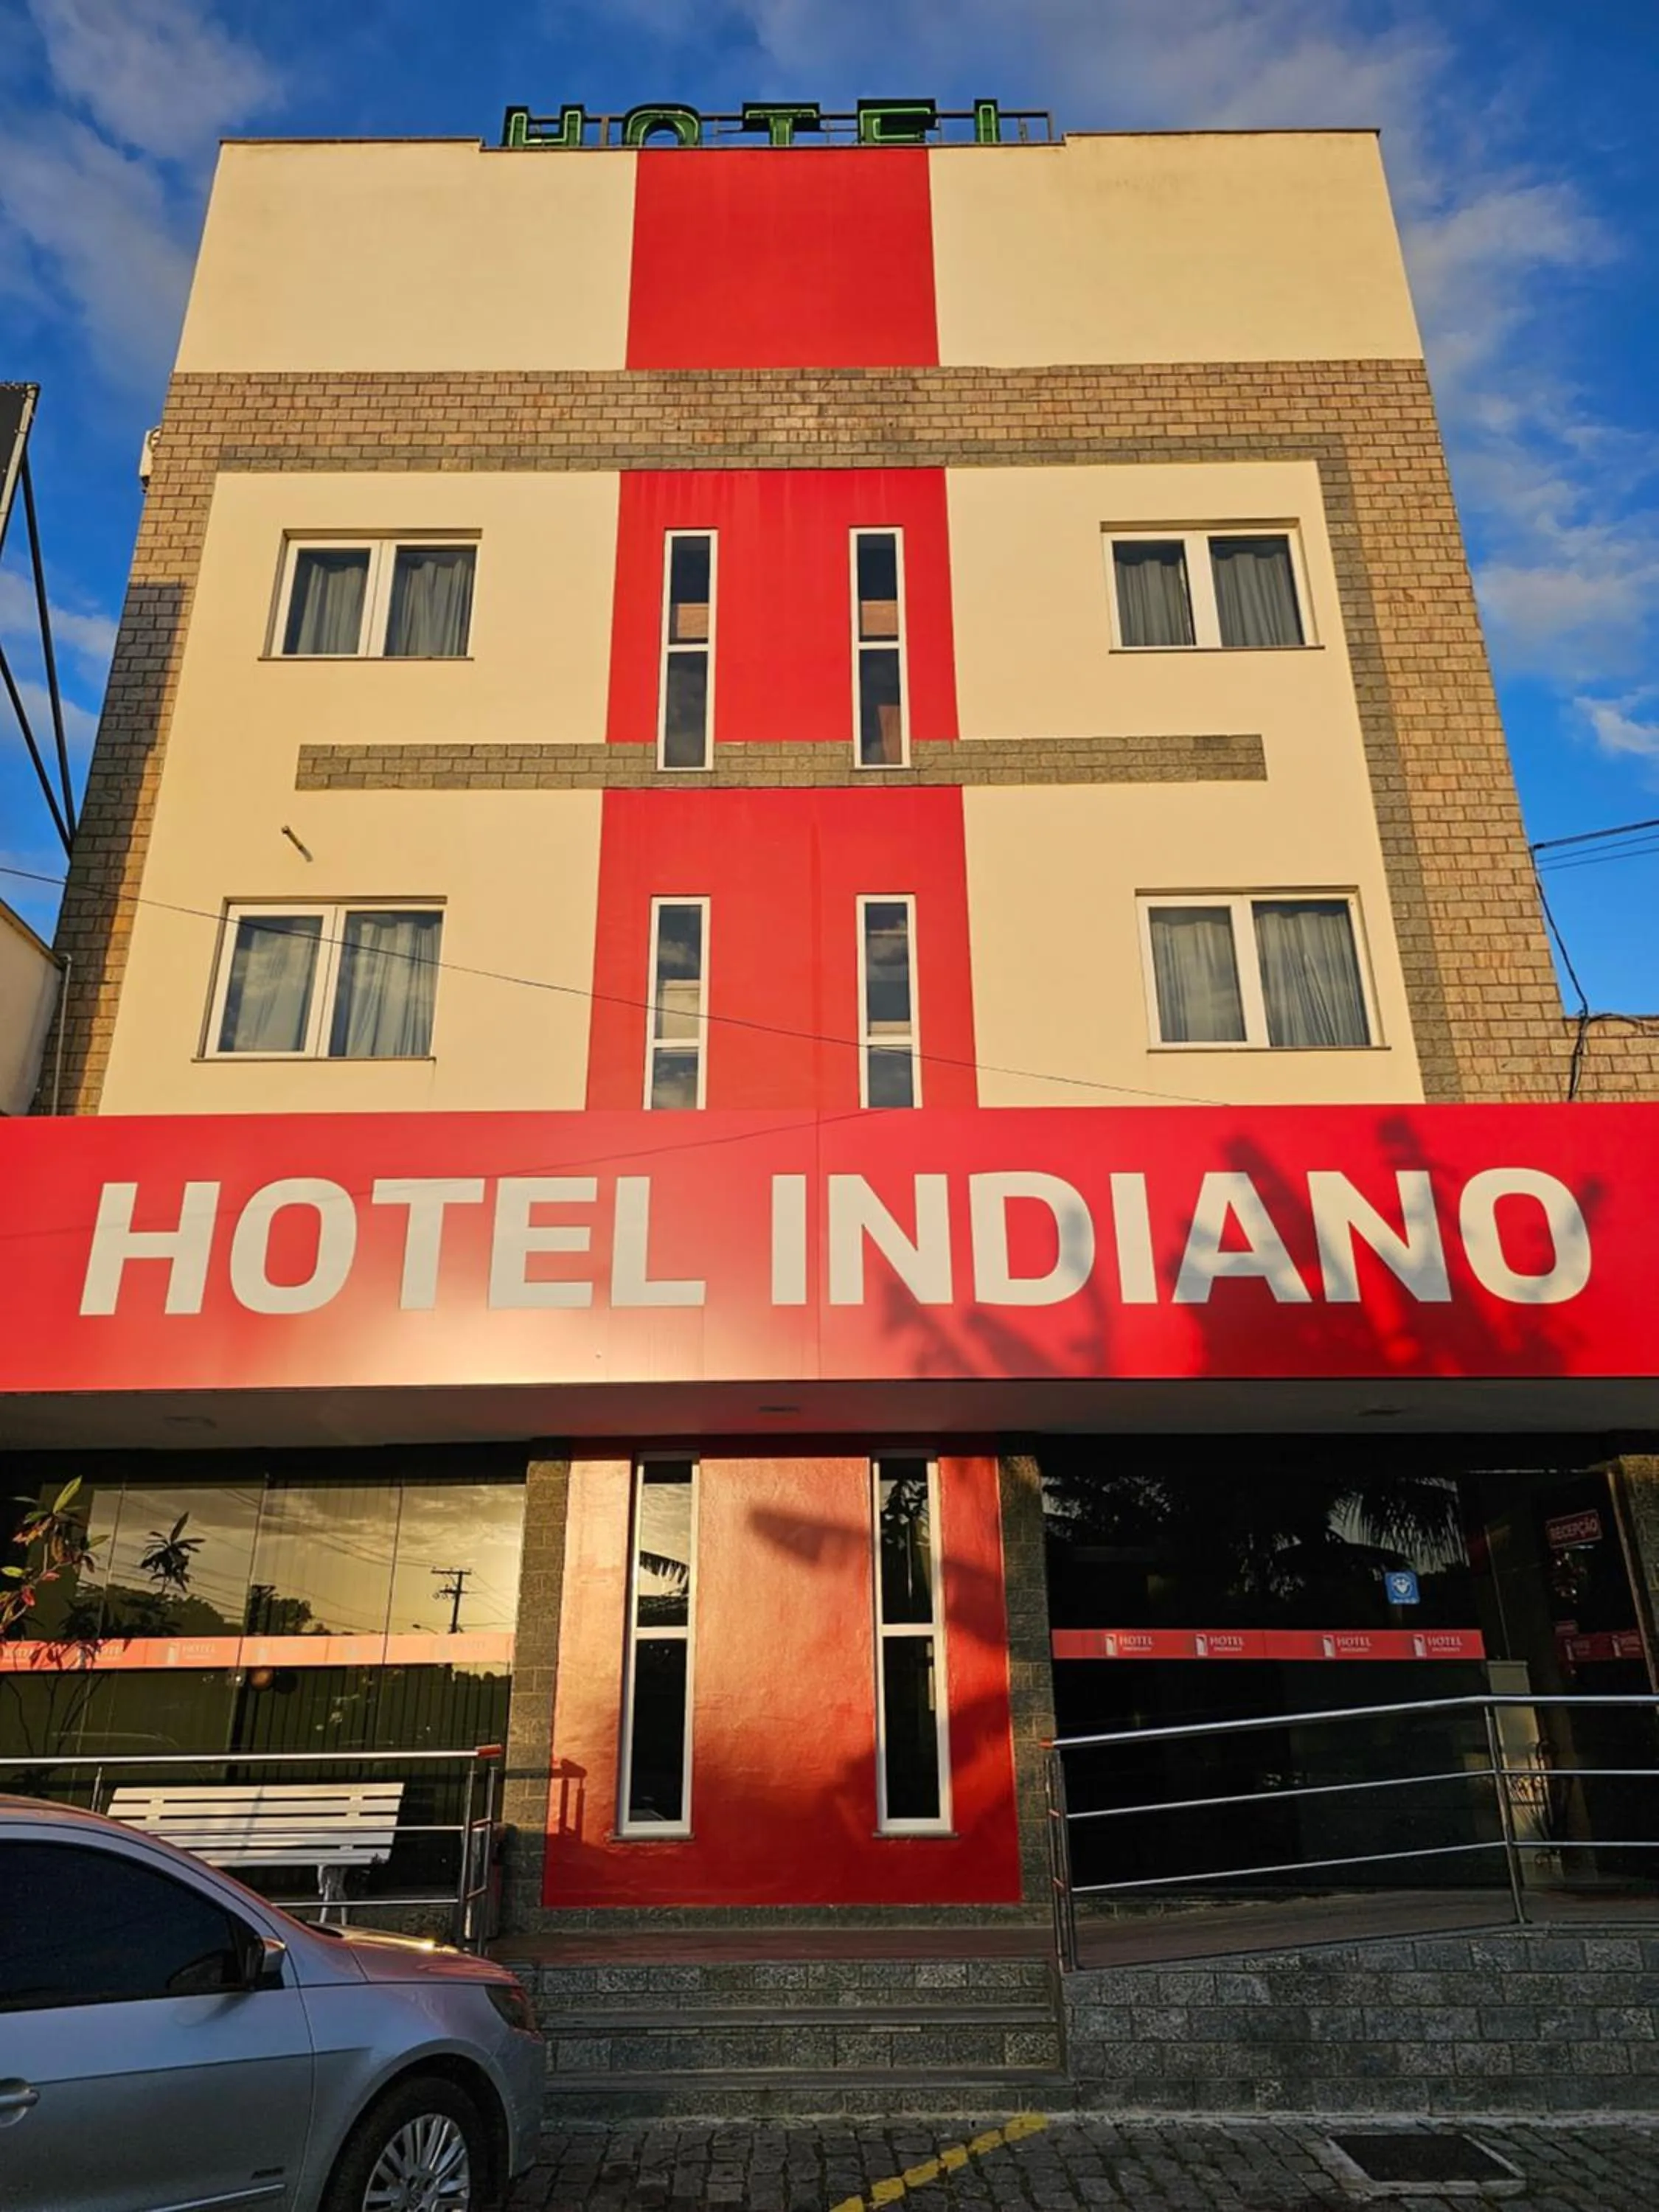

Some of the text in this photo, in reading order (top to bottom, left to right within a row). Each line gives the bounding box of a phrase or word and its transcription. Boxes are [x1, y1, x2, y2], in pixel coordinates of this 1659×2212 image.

[79, 1166, 1592, 1315] HOTEL INDIANO
[1119, 1635, 1152, 1646] HOTEL
[1209, 1635, 1244, 1646] HOTEL
[1336, 1636, 1371, 1646] HOTEL
[1427, 1636, 1463, 1646] HOTEL
